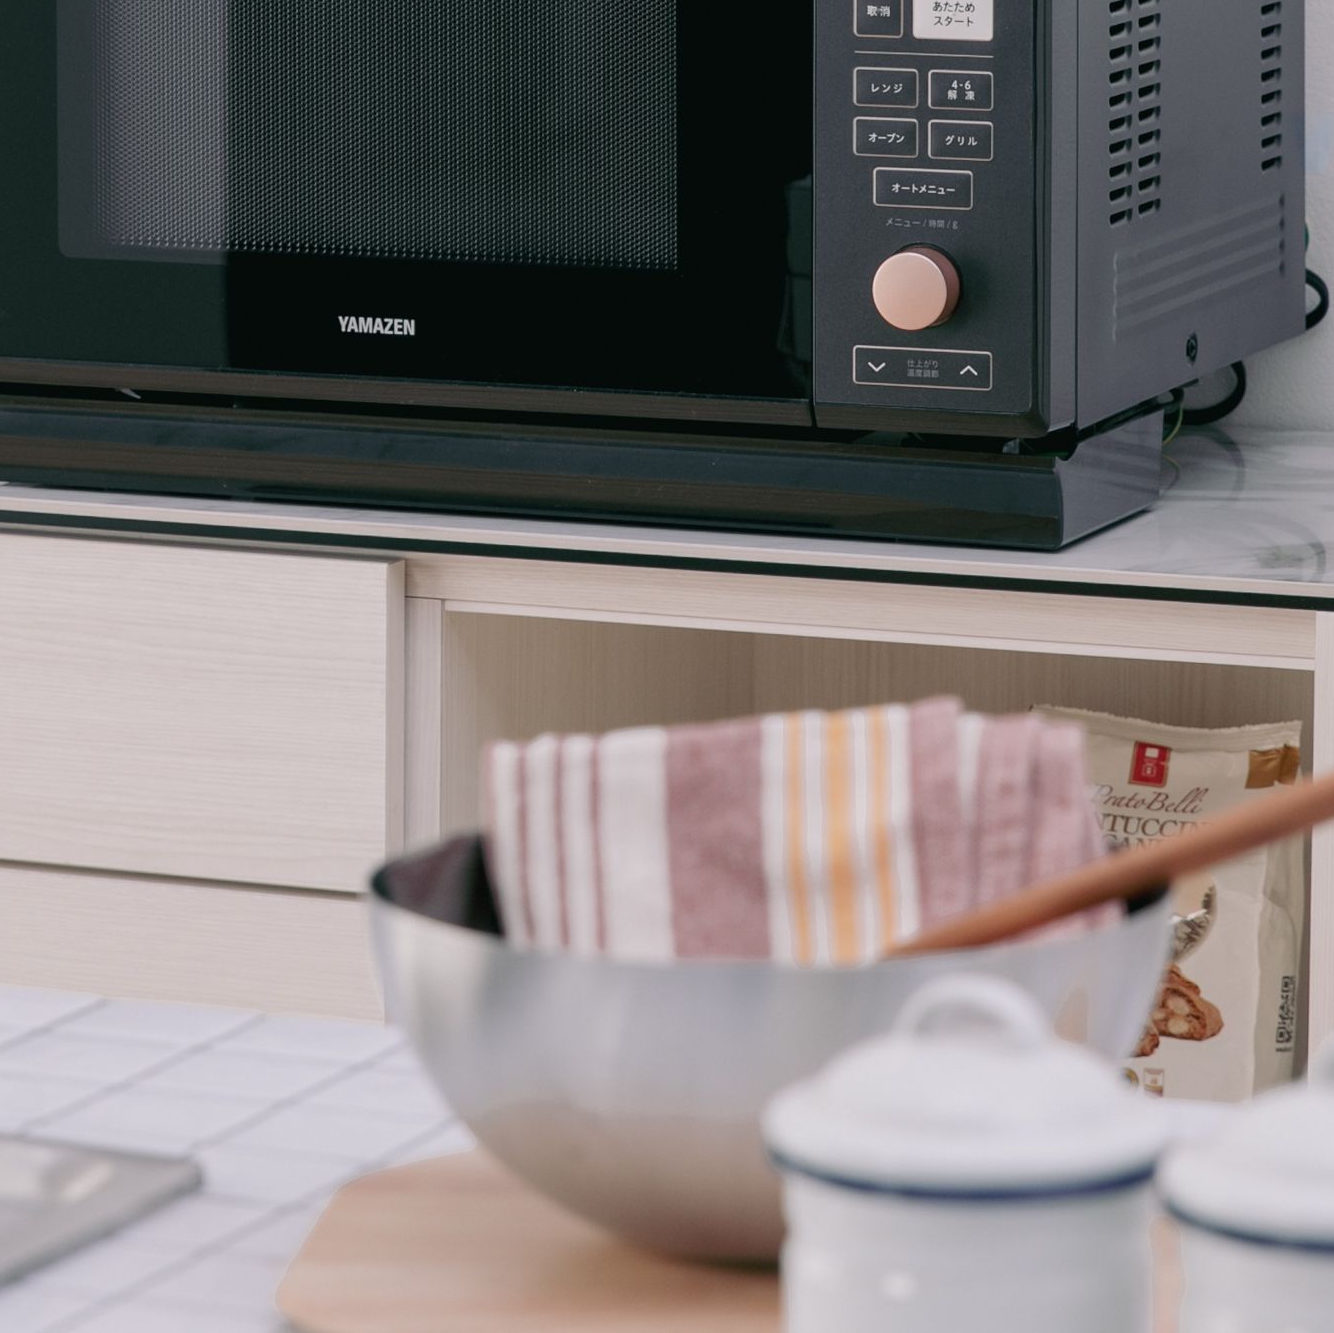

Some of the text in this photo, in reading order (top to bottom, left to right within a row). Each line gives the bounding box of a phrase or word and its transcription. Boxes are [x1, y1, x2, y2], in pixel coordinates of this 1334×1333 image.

[932, 1, 976, 14] あたため
[933, 16, 975, 27] スタート
[870, 83, 904, 94] レンジ
[868, 132, 905, 144] オープン
[945, 135, 979, 146] グリル
[891, 182, 956, 195] オートメニュー
[338, 315, 416, 336] YAMAZEN
